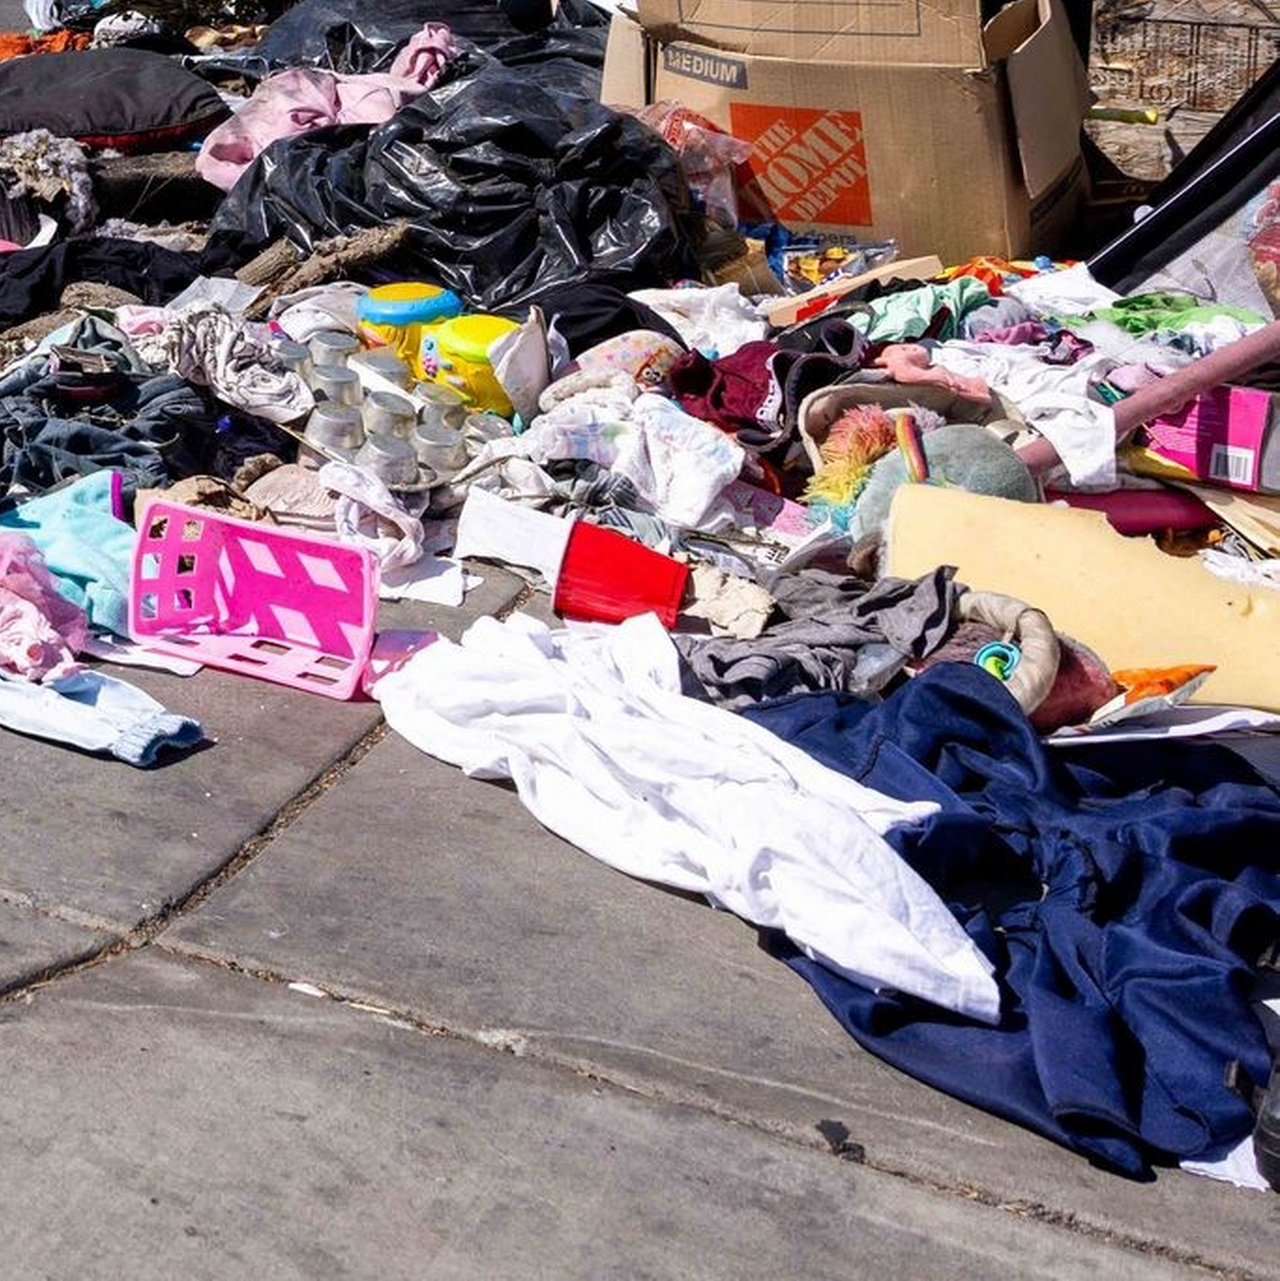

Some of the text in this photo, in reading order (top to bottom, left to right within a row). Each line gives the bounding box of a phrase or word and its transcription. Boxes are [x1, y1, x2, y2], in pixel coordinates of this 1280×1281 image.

[667, 49, 738, 84] MEDIUM
[751, 118, 797, 163] THE
[791, 153, 868, 221] DEPOT
